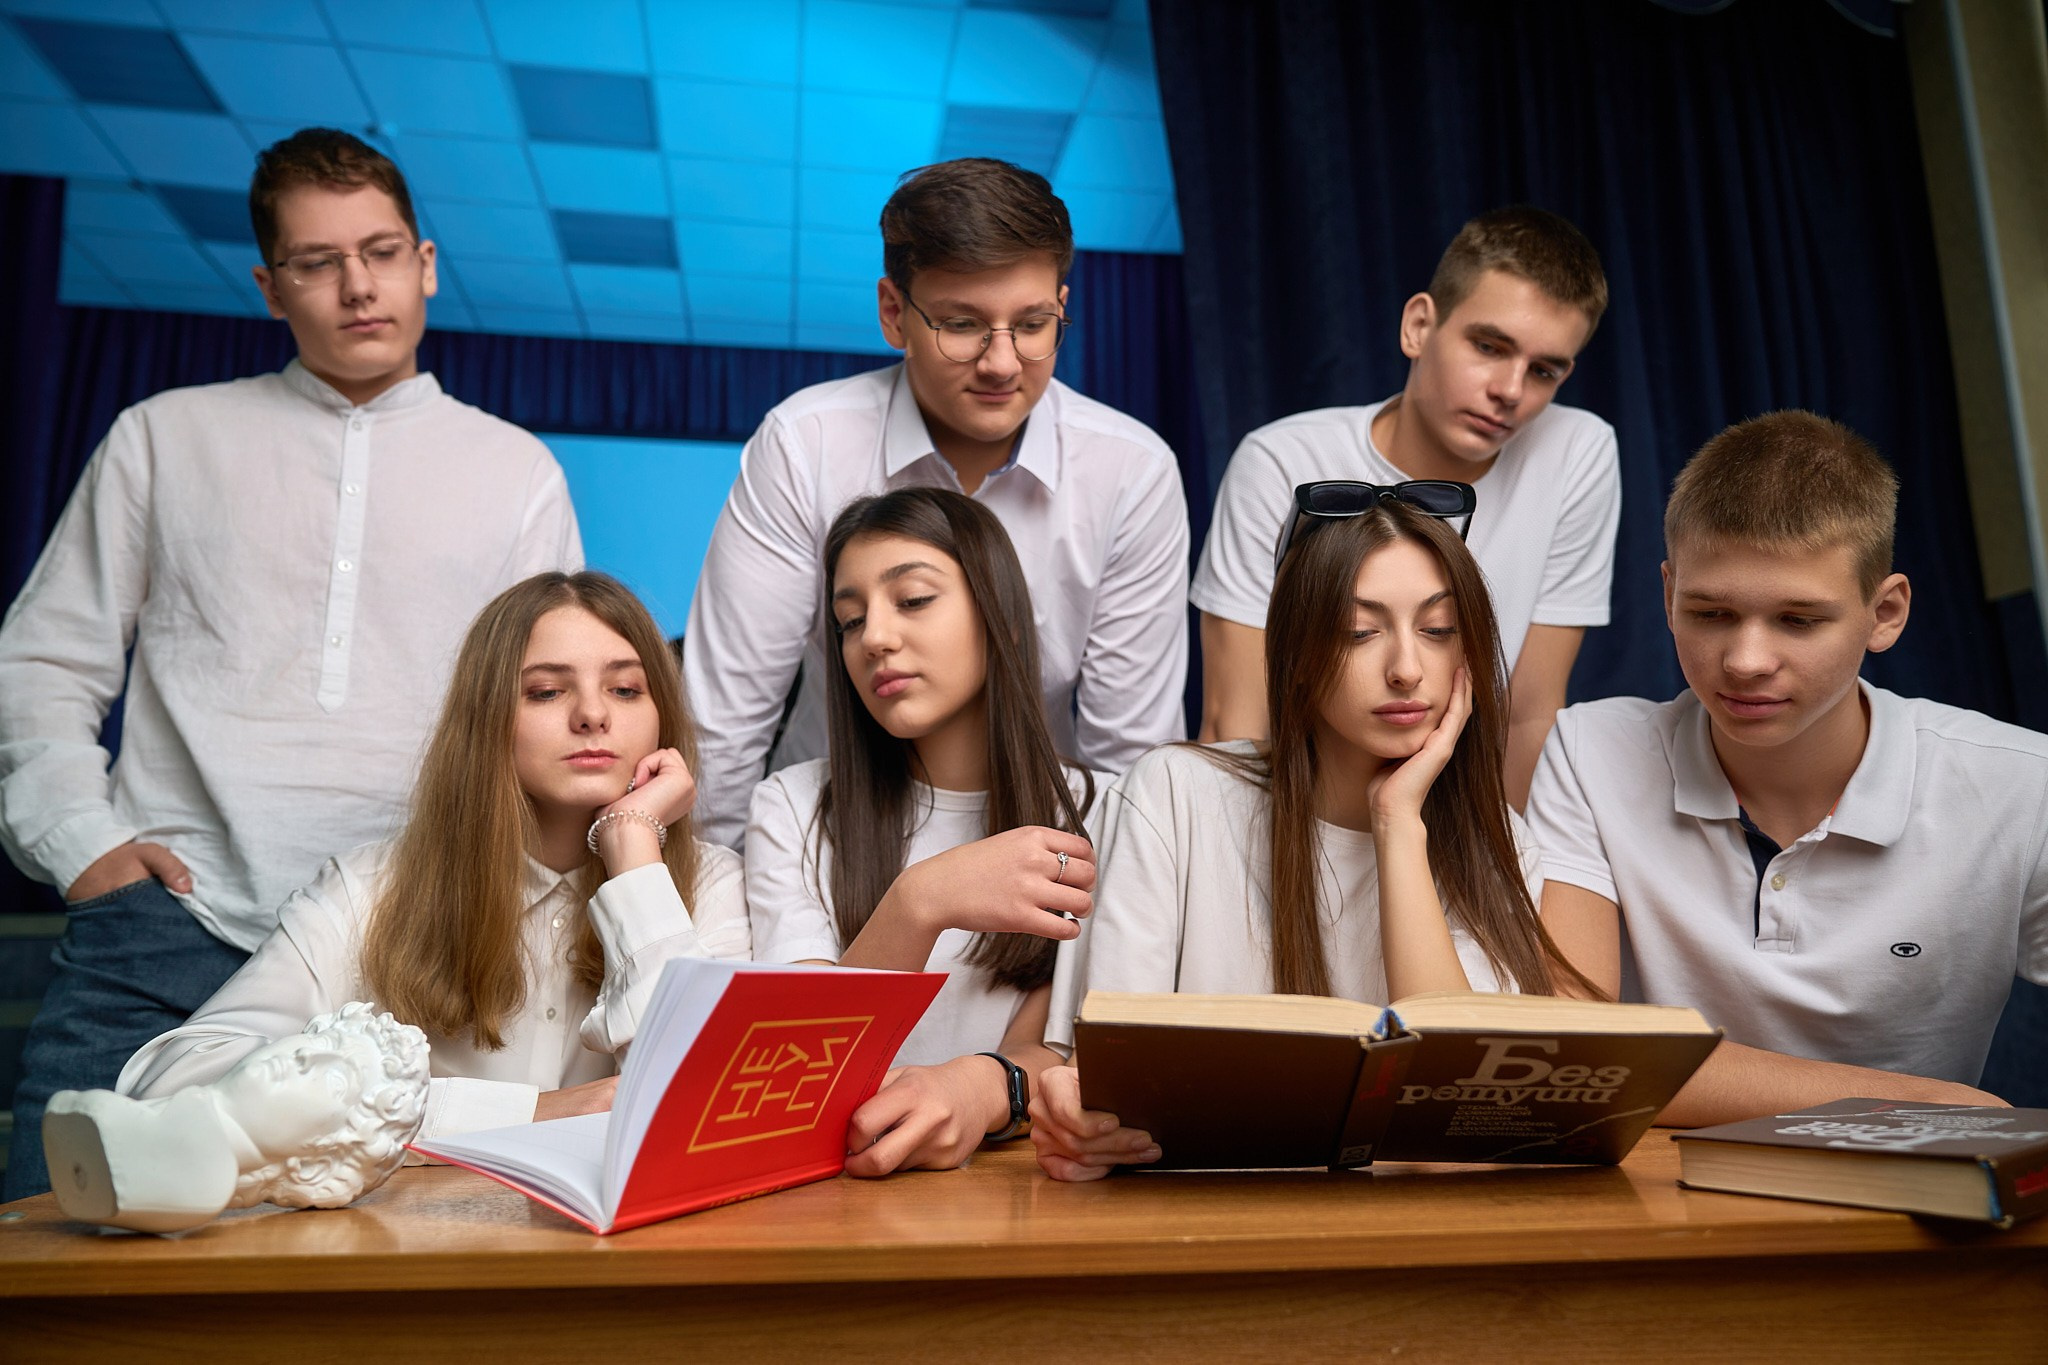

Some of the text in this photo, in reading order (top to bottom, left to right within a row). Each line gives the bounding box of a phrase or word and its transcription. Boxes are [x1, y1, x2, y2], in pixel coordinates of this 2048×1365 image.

[716, 1043, 787, 1122] НЕ
[752, 1042, 809, 1117] ТУ
[785, 1037, 849, 1112] ПИ
[1397, 1084, 1622, 1105] ретуши
[1454, 1037, 1631, 1087] Без
